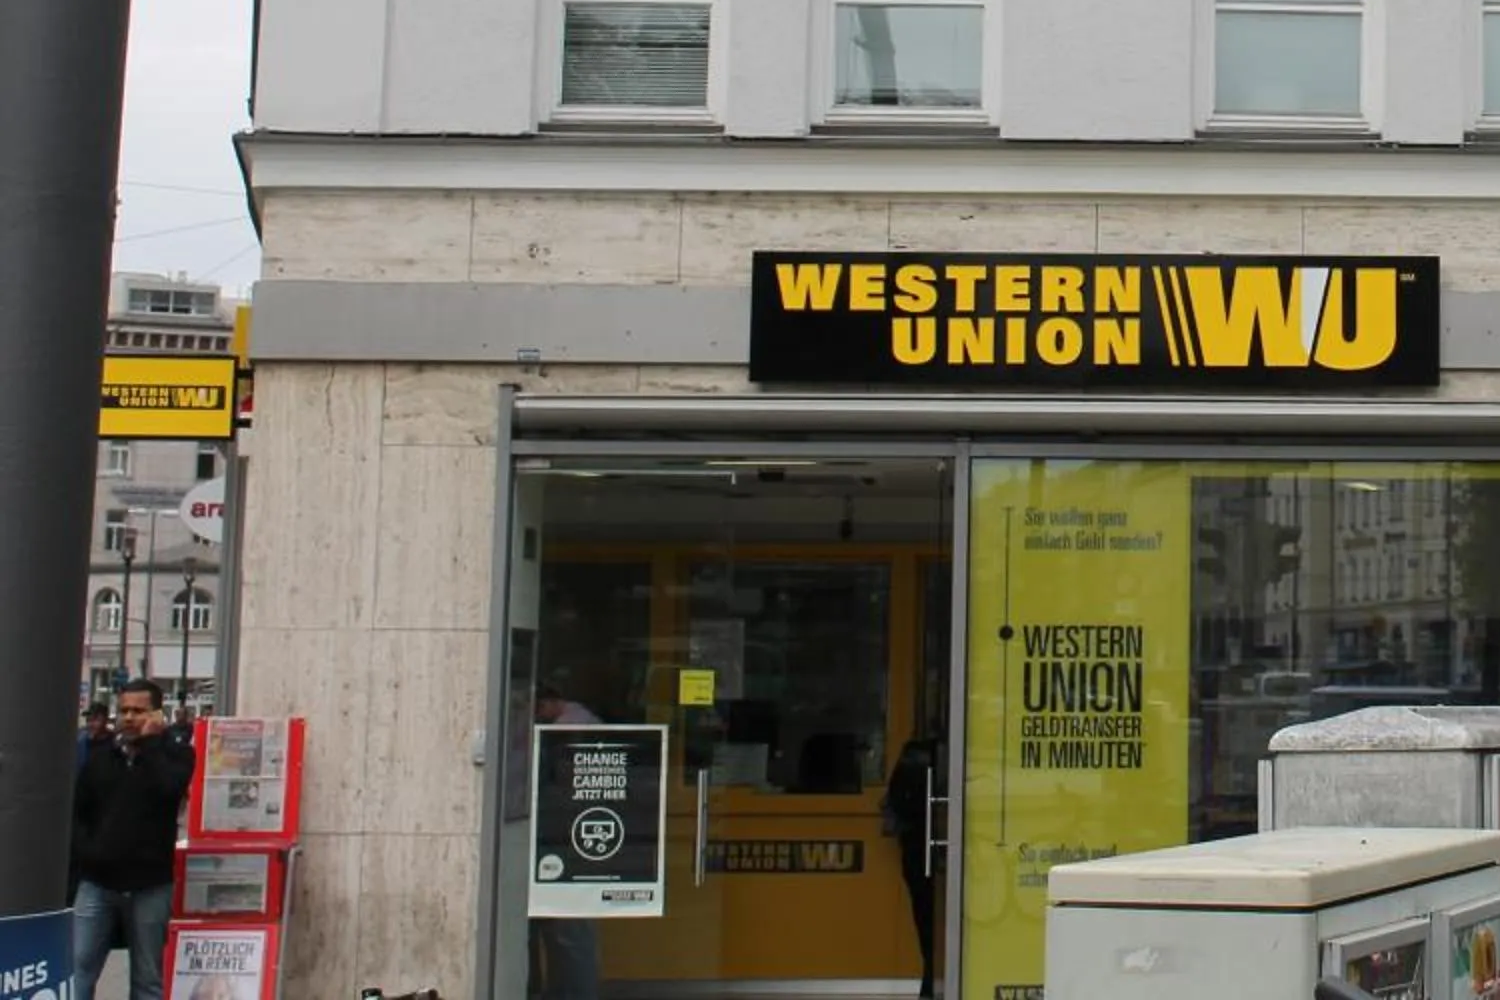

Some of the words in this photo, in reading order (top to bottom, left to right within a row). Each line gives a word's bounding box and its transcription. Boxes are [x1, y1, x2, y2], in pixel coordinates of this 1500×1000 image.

[775, 262, 1142, 314] WESTERN
[1184, 266, 1398, 371] WU
[890, 317, 1142, 367] UNION
[119, 397, 169, 408] UNION
[177, 387, 218, 408] WU
[1023, 625, 1143, 659] WESTERN
[1023, 662, 1143, 713] UNION
[1020, 715, 1142, 738] GELDTRANSFER
[573, 752, 628, 766] CHANGE
[1020, 742, 1041, 769] IN
[1048, 741, 1143, 770] MINUTEN
[572, 775, 627, 788] CAMBIO
[571, 789, 601, 801] JETZT
[602, 789, 627, 801] HIER
[189, 956, 203, 970] IN
[205, 956, 246, 971] RENTE
[0, 960, 49, 995] NES
